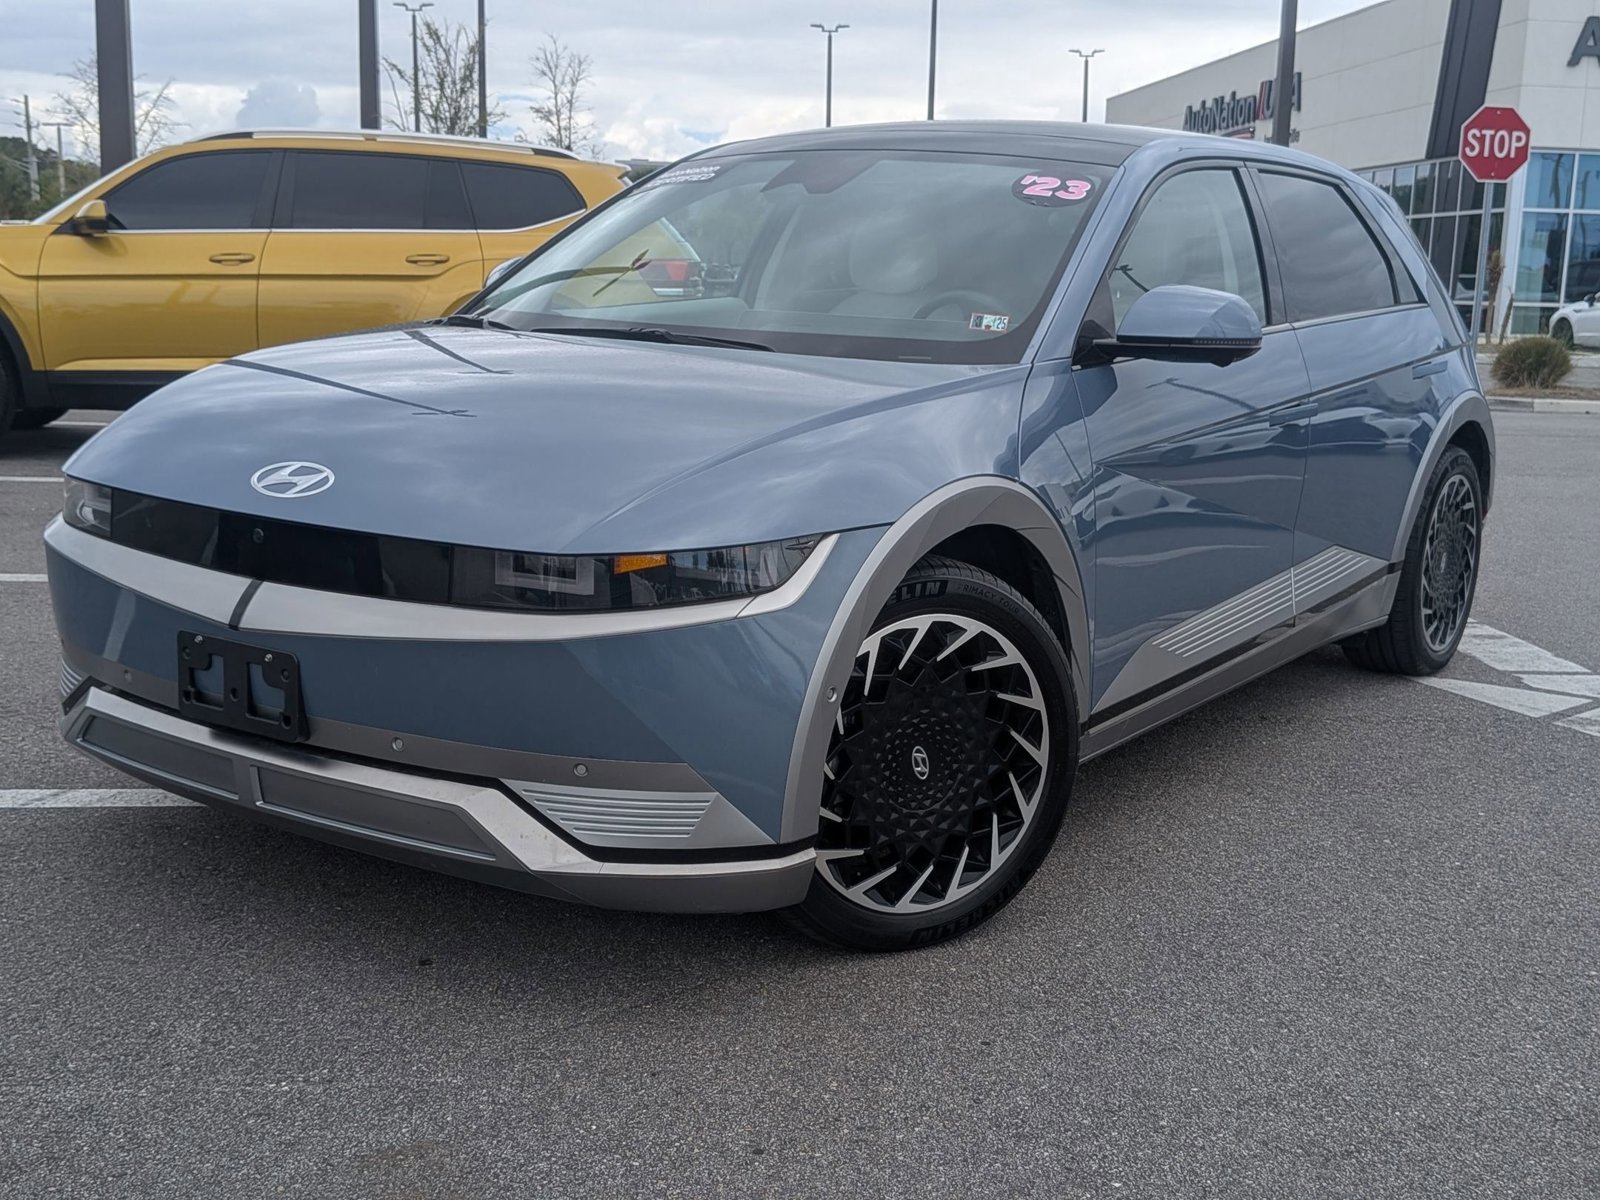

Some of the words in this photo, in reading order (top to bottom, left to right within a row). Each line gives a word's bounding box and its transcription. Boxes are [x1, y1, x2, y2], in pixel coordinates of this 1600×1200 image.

[1182, 91, 1258, 134] AutoNation
[1464, 128, 1527, 159] STOP
[1020, 175, 1092, 200] '23
